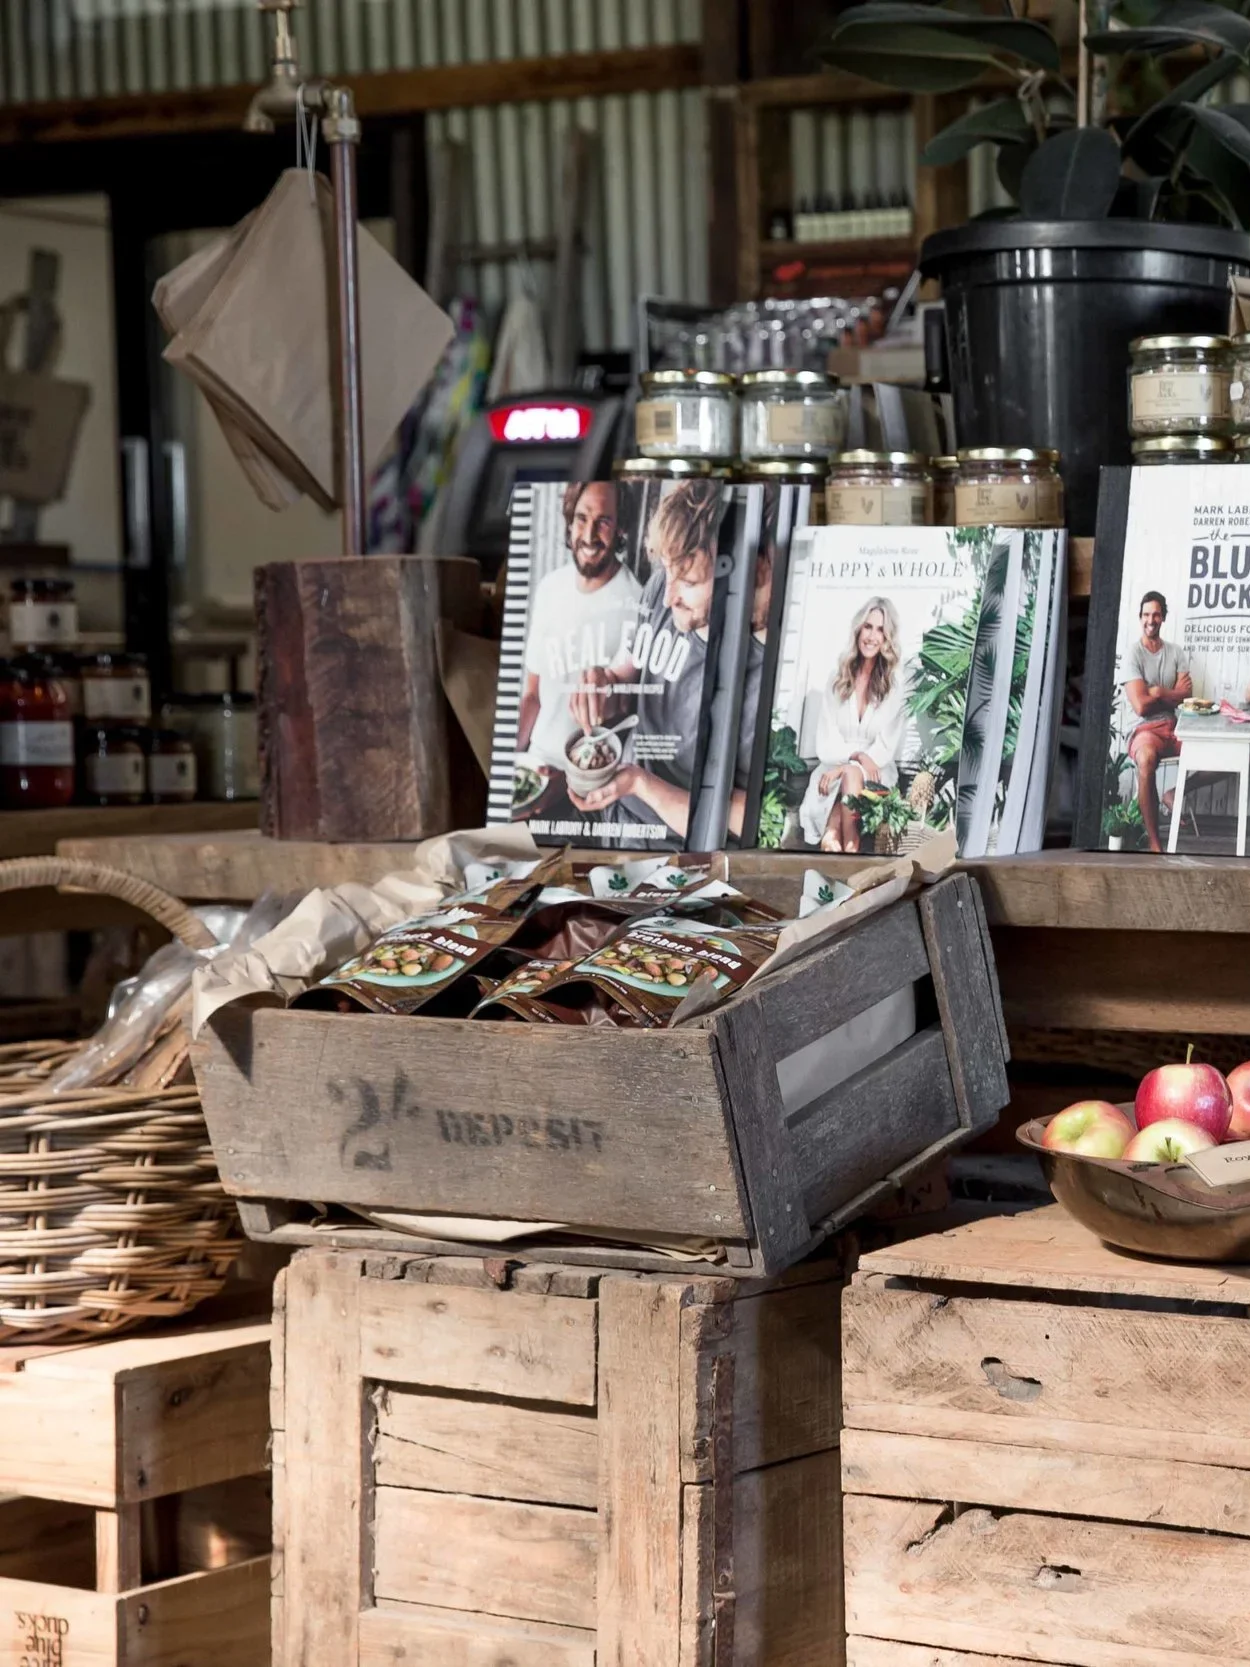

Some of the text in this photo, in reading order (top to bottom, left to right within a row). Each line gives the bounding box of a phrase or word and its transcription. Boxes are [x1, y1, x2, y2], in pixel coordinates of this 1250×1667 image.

[1194, 505, 1224, 515] MARK
[1193, 517, 1225, 527] DARREN
[1210, 528, 1229, 541] the
[810, 561, 964, 578] HAPPY & WHOLE
[1184, 624, 1237, 634] DELICIOUS
[1194, 635, 1225, 644] IMPORTANCE
[547, 620, 691, 683] REAL FOOD
[1183, 645, 1196, 653] AND
[1198, 645, 1210, 653] THE
[1212, 645, 1224, 653] JOY
[1226, 645, 1235, 653] OF
[527, 819, 667, 840] MARK LABROOY & DARREN ROBERTSON
[433, 936, 477, 957] blend
[696, 949, 742, 970] blend
[14, 1610, 69, 1640] ducks
[25, 1633, 62, 1661] blue
